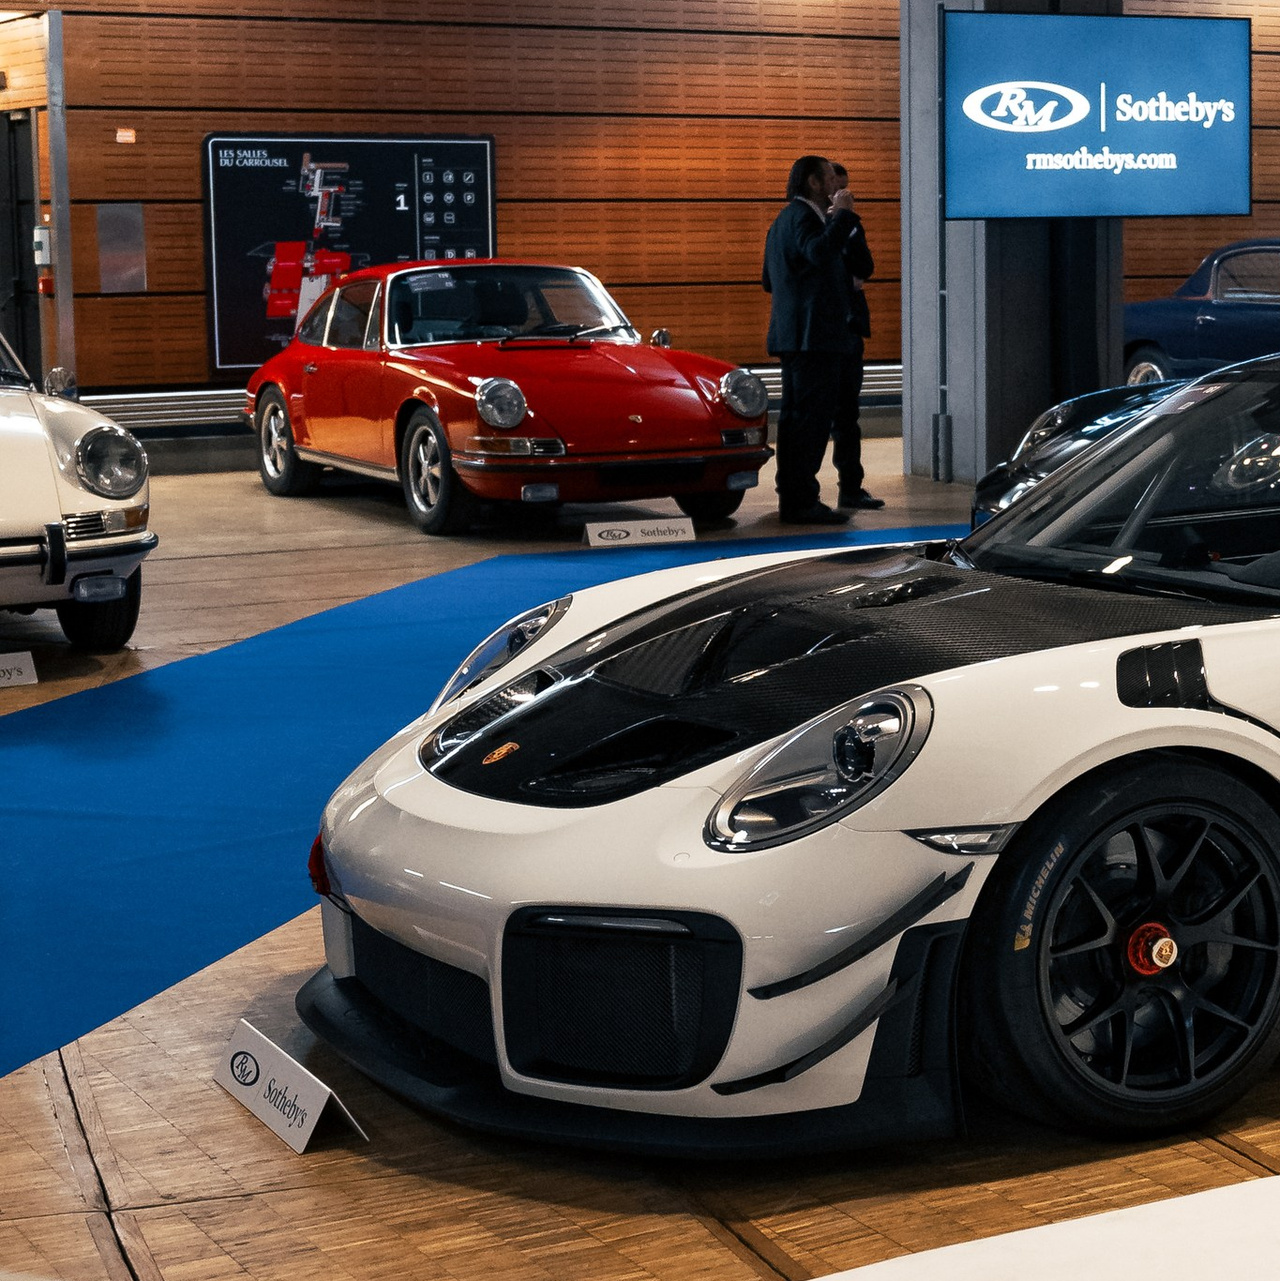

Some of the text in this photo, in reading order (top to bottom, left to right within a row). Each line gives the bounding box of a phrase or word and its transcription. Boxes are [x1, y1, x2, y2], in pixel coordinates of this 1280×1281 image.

[1116, 91, 1235, 128] Sotheby's
[219, 150, 268, 158] LES SALLES
[219, 159, 289, 167] DU CARROUSEL
[1025, 146, 1177, 174] rmsothebys.com
[395, 194, 409, 210] 1
[640, 527, 687, 538] Sotheby's
[1023, 841, 1065, 921] MICHELIN
[263, 1077, 308, 1129] Sotheby's
